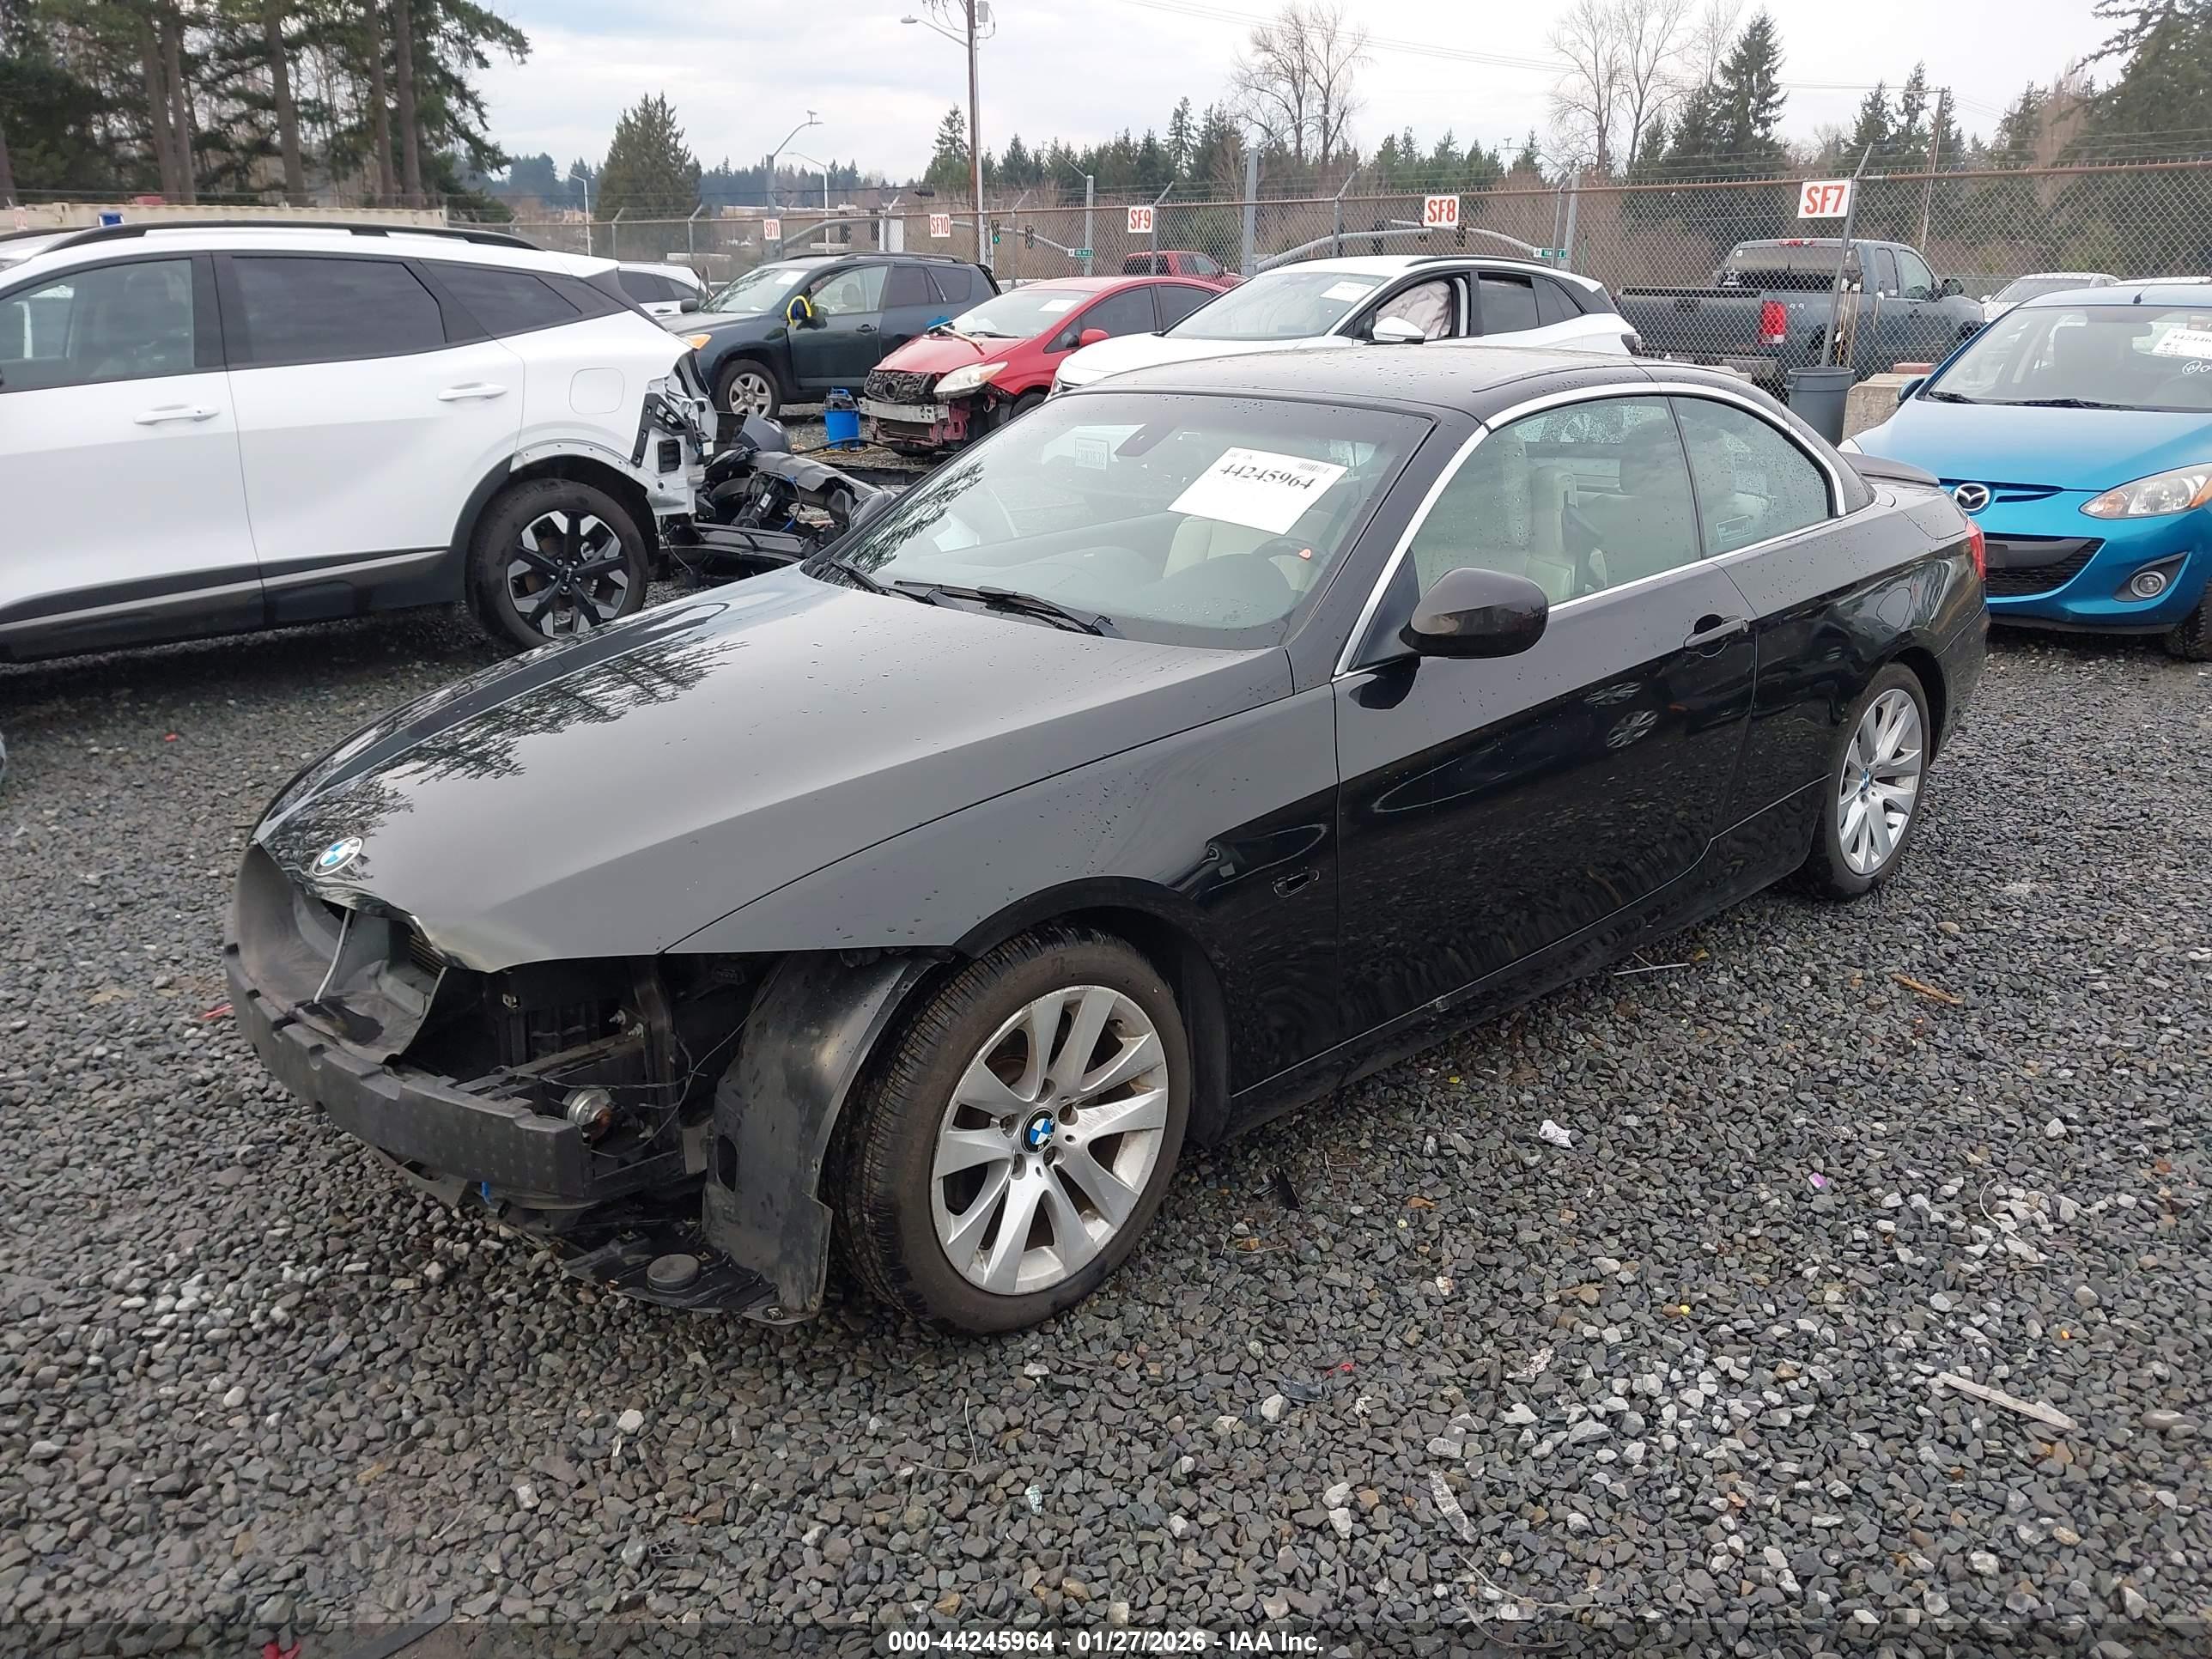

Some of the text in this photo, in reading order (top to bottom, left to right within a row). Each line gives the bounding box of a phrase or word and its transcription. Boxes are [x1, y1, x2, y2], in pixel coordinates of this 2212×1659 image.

[1427, 198, 1455, 222] SF8
[1805, 185, 1845, 214] SF7
[765, 221, 779, 238] SF11
[931, 216, 949, 234] SF10
[1130, 209, 1151, 229] SF9
[1219, 463, 1316, 489] 44245964
